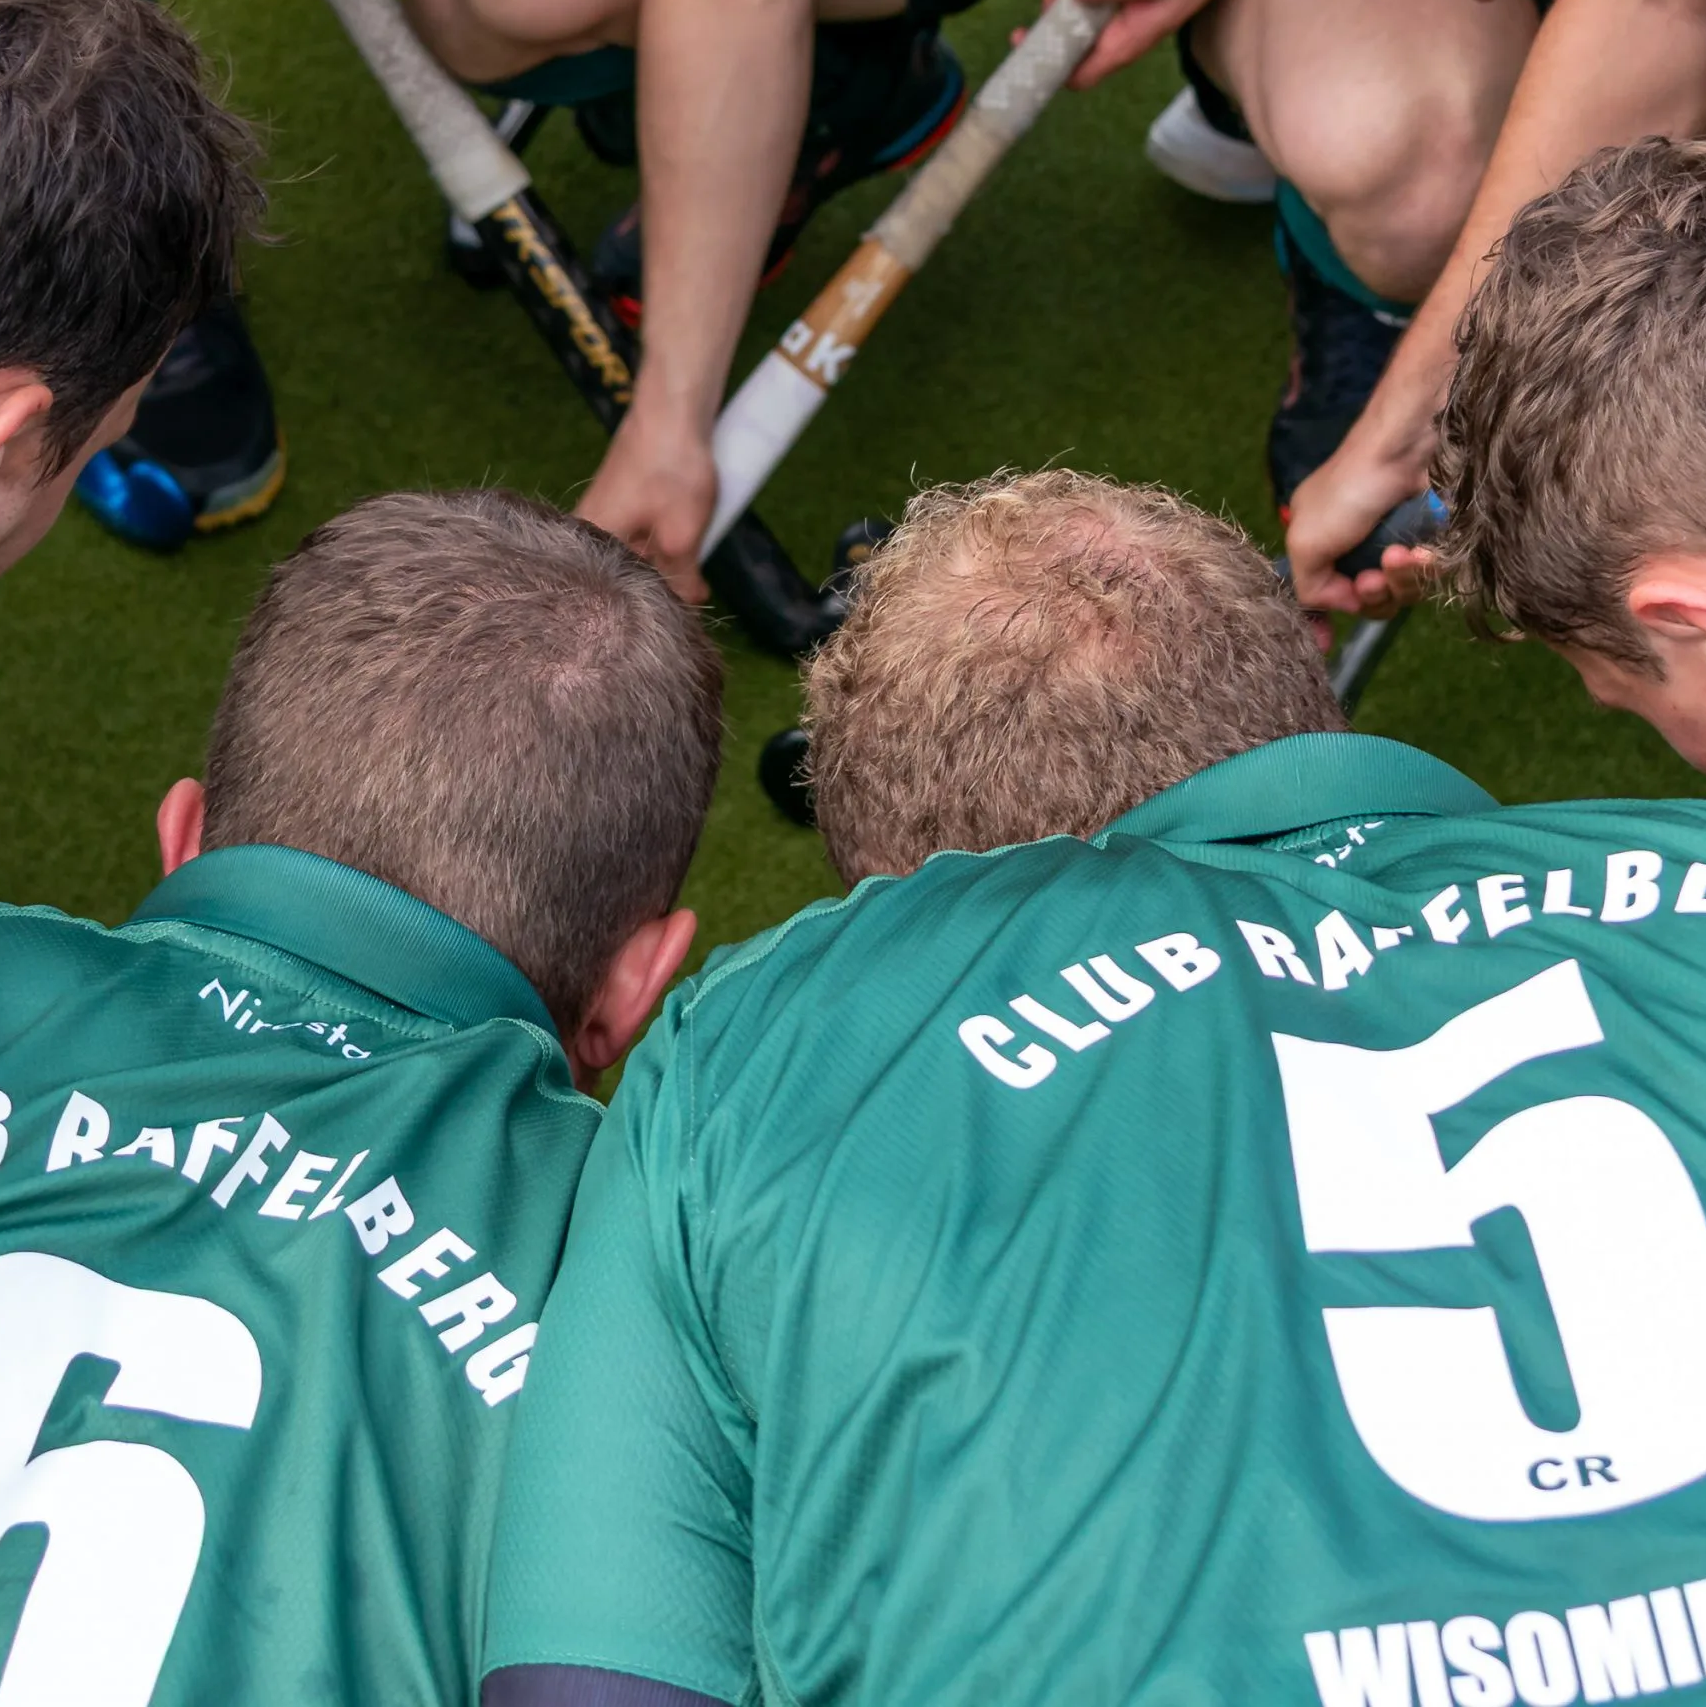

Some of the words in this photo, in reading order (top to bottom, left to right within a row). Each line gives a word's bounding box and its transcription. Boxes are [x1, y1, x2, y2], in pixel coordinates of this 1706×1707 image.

[957, 930, 1222, 1091] CLUB
[45, 1090, 541, 1408] RAFFELBERG
[1527, 1452, 1623, 1494] CR
